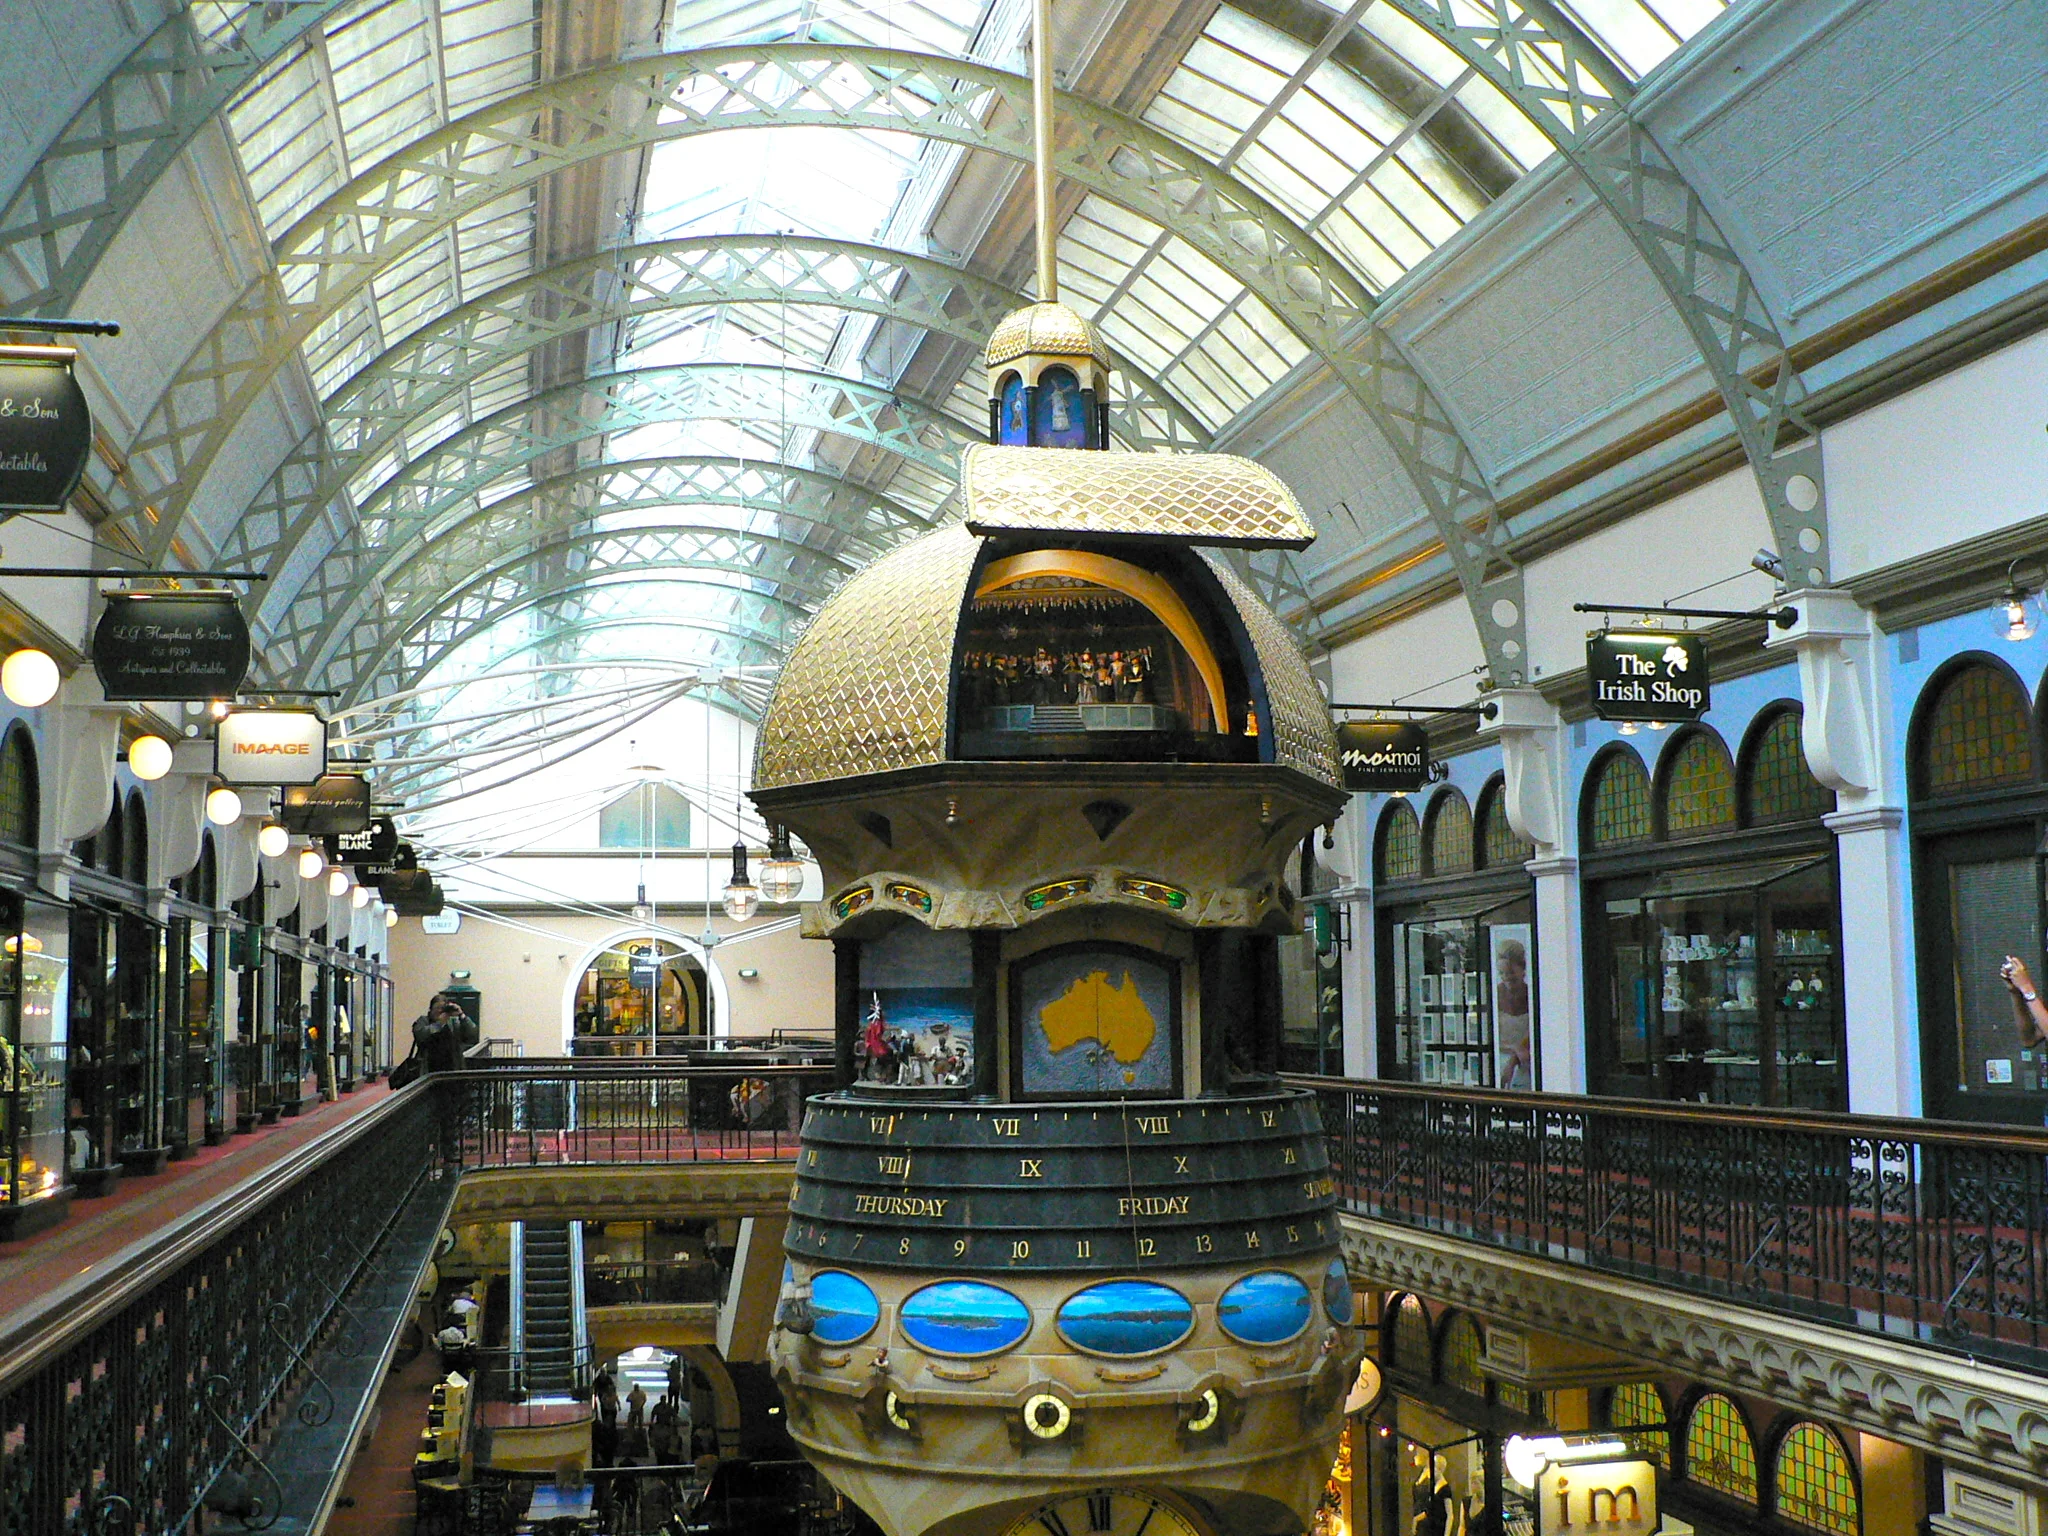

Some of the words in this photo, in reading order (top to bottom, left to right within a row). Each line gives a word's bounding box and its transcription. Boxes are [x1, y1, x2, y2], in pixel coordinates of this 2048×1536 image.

[0, 398, 19, 417] &
[21, 397, 59, 419] Sons
[195, 626, 206, 640] &
[208, 625, 233, 640] Sons
[1615, 653, 1656, 677] The
[1597, 679, 1647, 701] Irish
[1650, 680, 1702, 710] Shop
[232, 742, 310, 756] IMAAGE
[338, 840, 373, 851] BLANC
[992, 1118, 1021, 1136] VII
[1135, 1116, 1171, 1135] VIII
[1019, 1159, 1043, 1178] IX
[1173, 1156, 1190, 1174] X
[855, 1194, 949, 1218] THURSDAY
[1118, 1196, 1190, 1216] FRIDAY
[818, 1231, 827, 1247] 6
[853, 1233, 864, 1251] 7
[899, 1237, 911, 1255] 8
[954, 1239, 965, 1258] 9
[1011, 1240, 1030, 1259] 10
[1077, 1240, 1091, 1258] 11
[1138, 1237, 1157, 1257] 12
[1196, 1234, 1213, 1253] 13
[1246, 1230, 1261, 1249] 14
